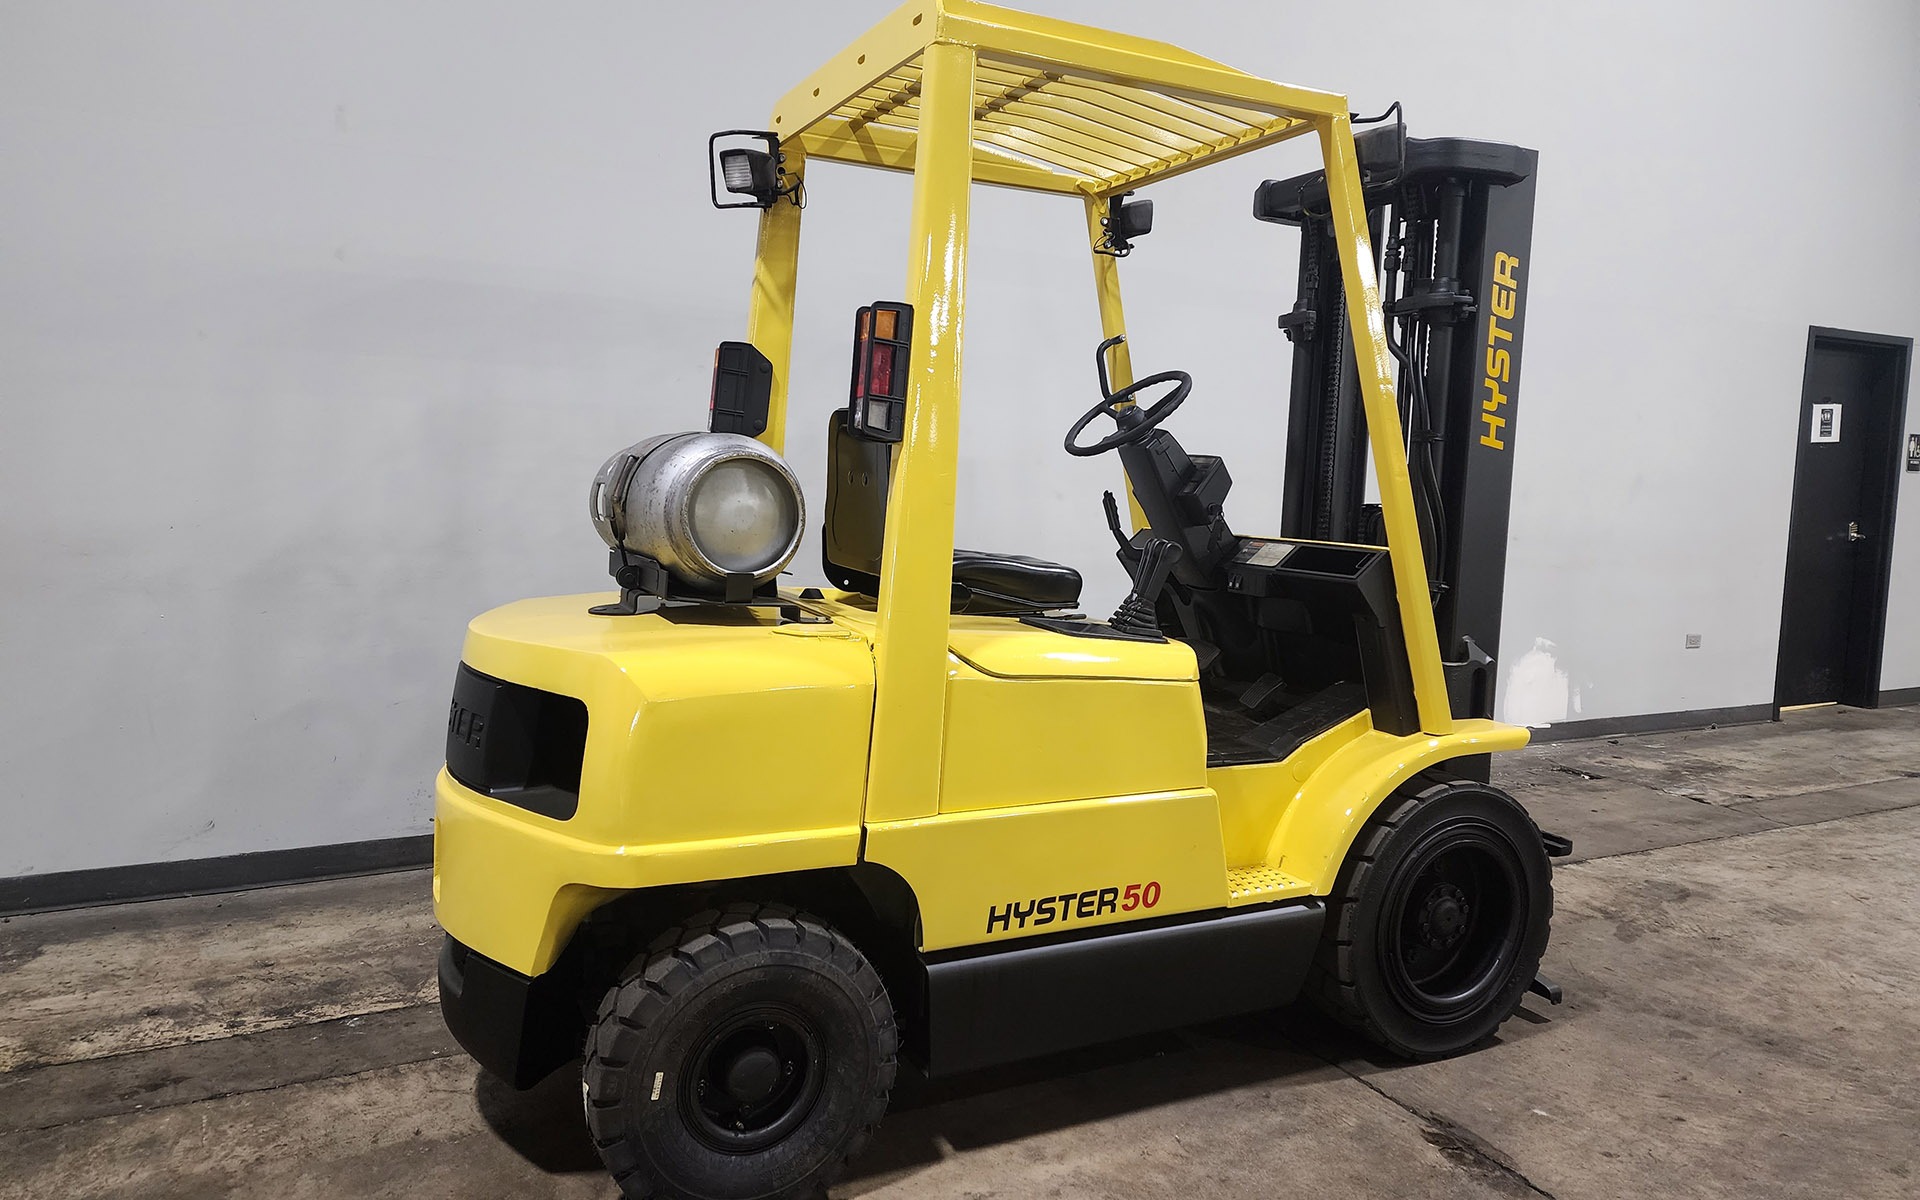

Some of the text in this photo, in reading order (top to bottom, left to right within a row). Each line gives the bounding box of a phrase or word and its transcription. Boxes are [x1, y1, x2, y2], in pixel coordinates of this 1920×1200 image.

[1480, 251, 1519, 450] HYSTER
[986, 881, 1161, 934] HYSTER 50
